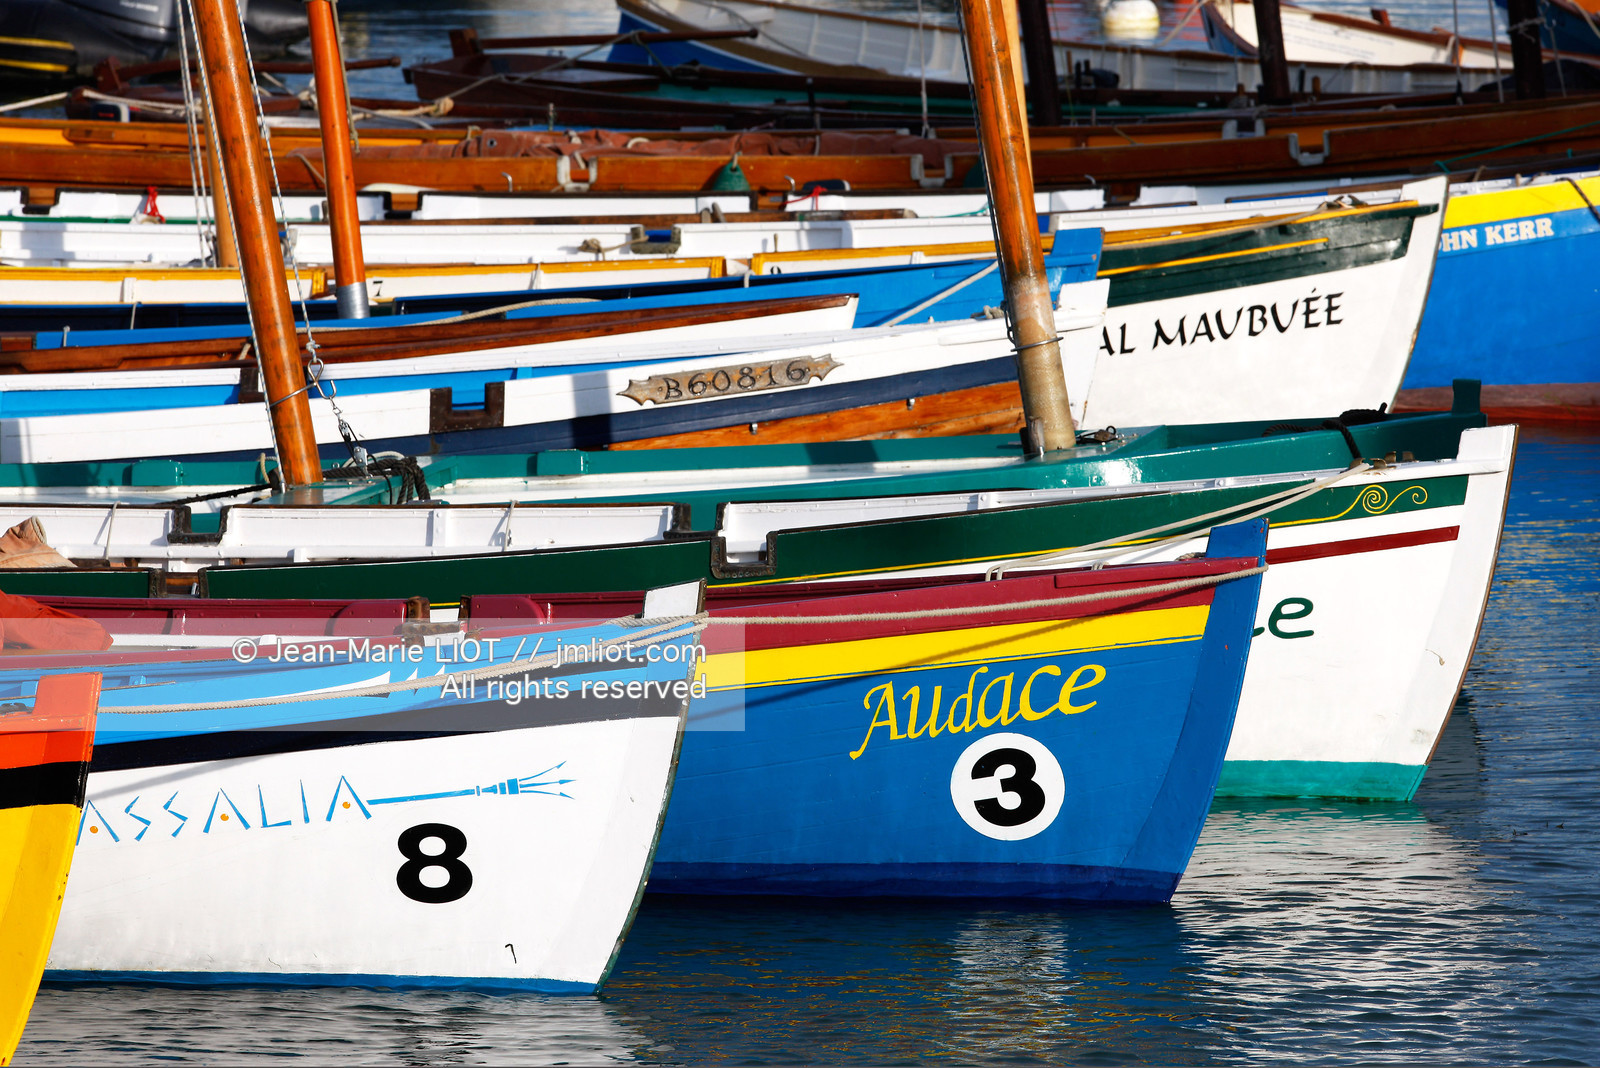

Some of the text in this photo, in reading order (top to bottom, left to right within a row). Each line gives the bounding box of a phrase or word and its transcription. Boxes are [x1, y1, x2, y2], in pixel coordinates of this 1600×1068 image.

[1438, 217, 1554, 252] HN KERR
[372, 280, 383, 297] 7
[1152, 287, 1345, 351] MAUBUÉE
[849, 664, 1107, 760] Audace
[76, 775, 372, 846] ASSALIA
[970, 747, 1046, 827] 3
[396, 822, 473, 905] 8
